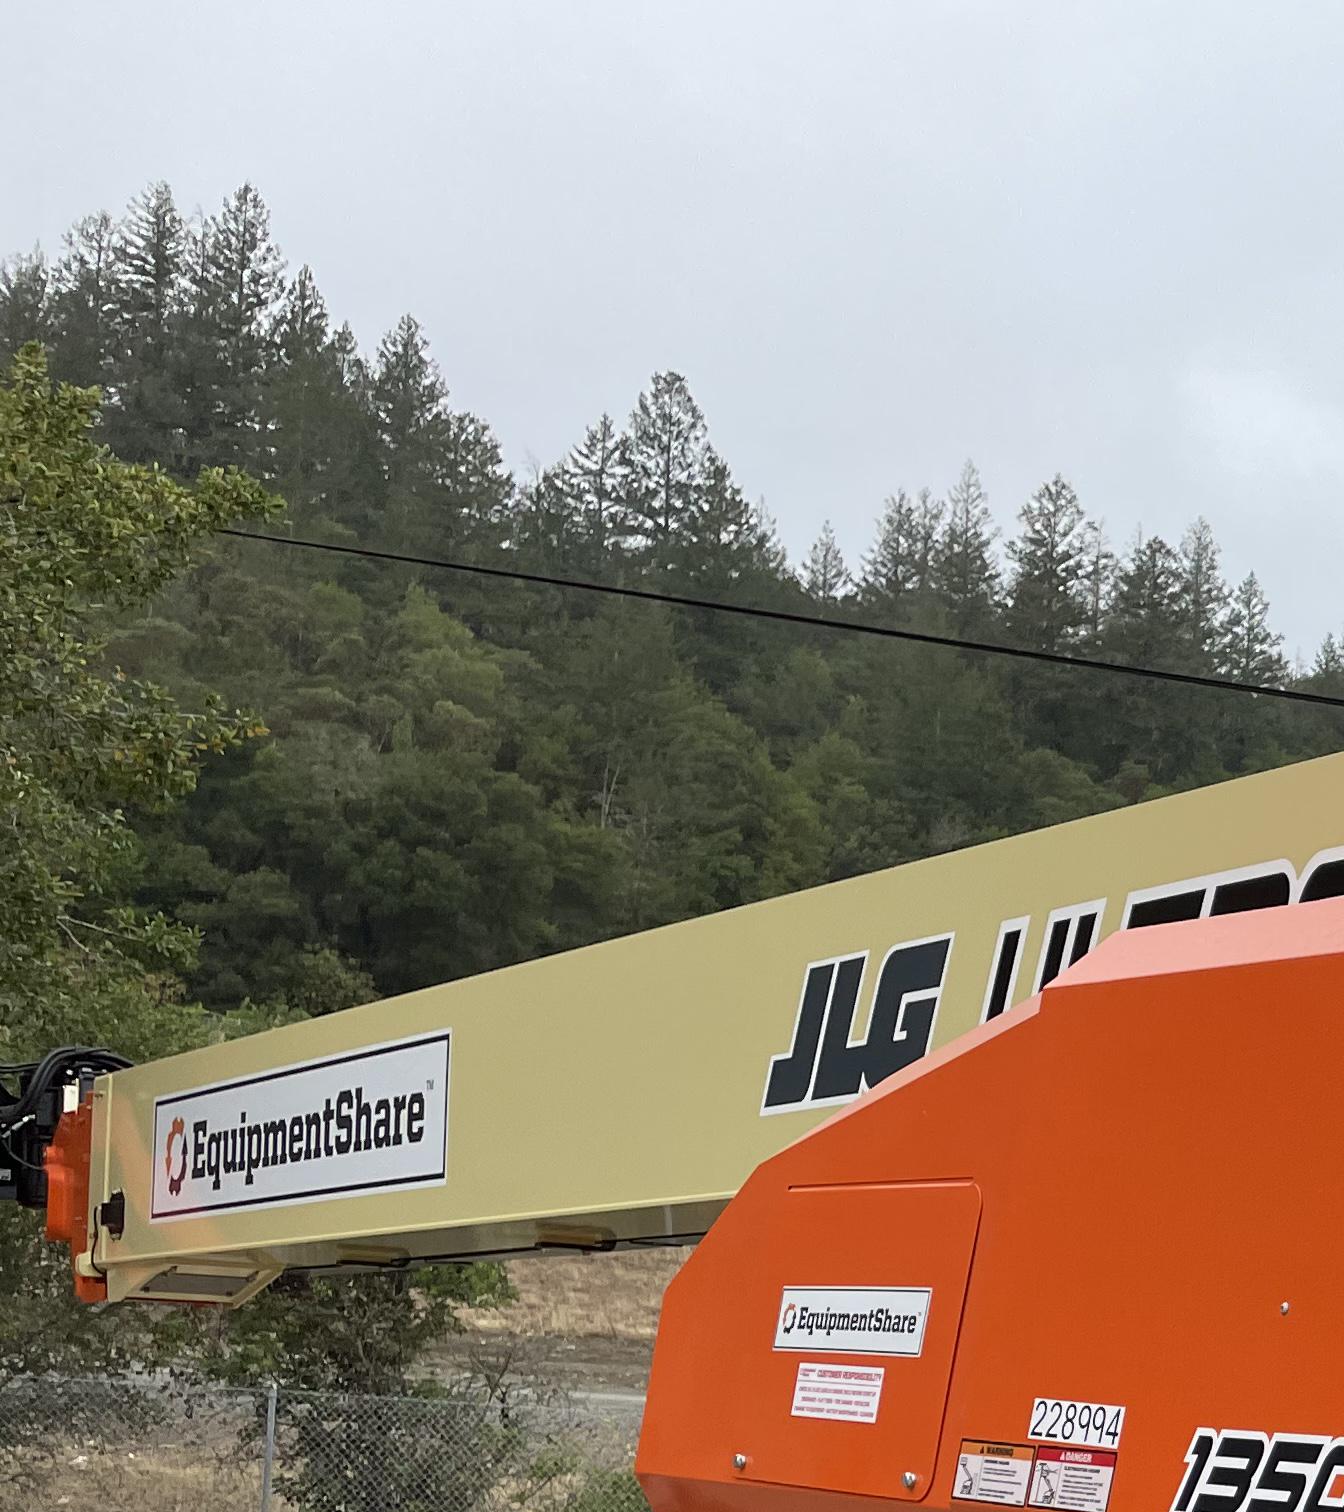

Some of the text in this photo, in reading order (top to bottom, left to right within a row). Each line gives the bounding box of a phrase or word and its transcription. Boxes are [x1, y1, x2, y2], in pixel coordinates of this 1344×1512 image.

[761, 934, 953, 1113] JLG
[192, 1088, 424, 1190] EquipmentShare
[797, 1307, 917, 1336] EquipmentShare
[1030, 1401, 1121, 1445] 228994
